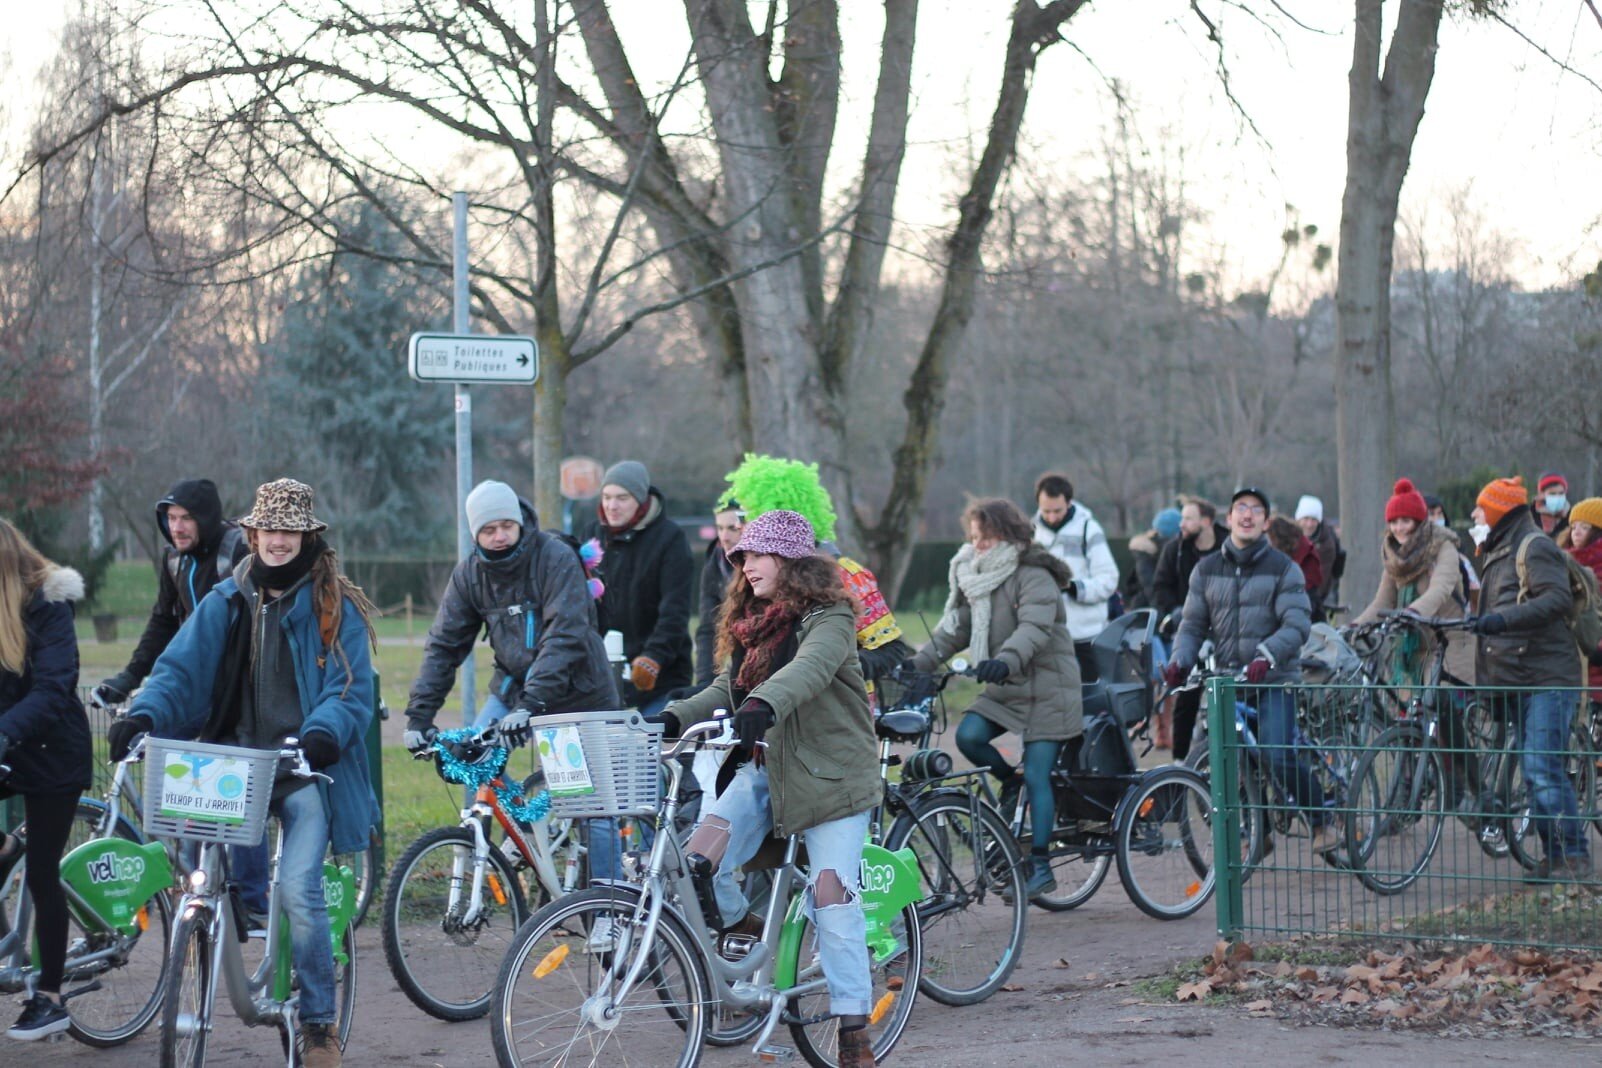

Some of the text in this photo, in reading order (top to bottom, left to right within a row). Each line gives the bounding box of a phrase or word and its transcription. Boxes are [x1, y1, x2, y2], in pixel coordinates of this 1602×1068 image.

[454, 345, 504, 358] Toilettes
[453, 360, 507, 373] Publiques
[194, 796, 203, 808] ET
